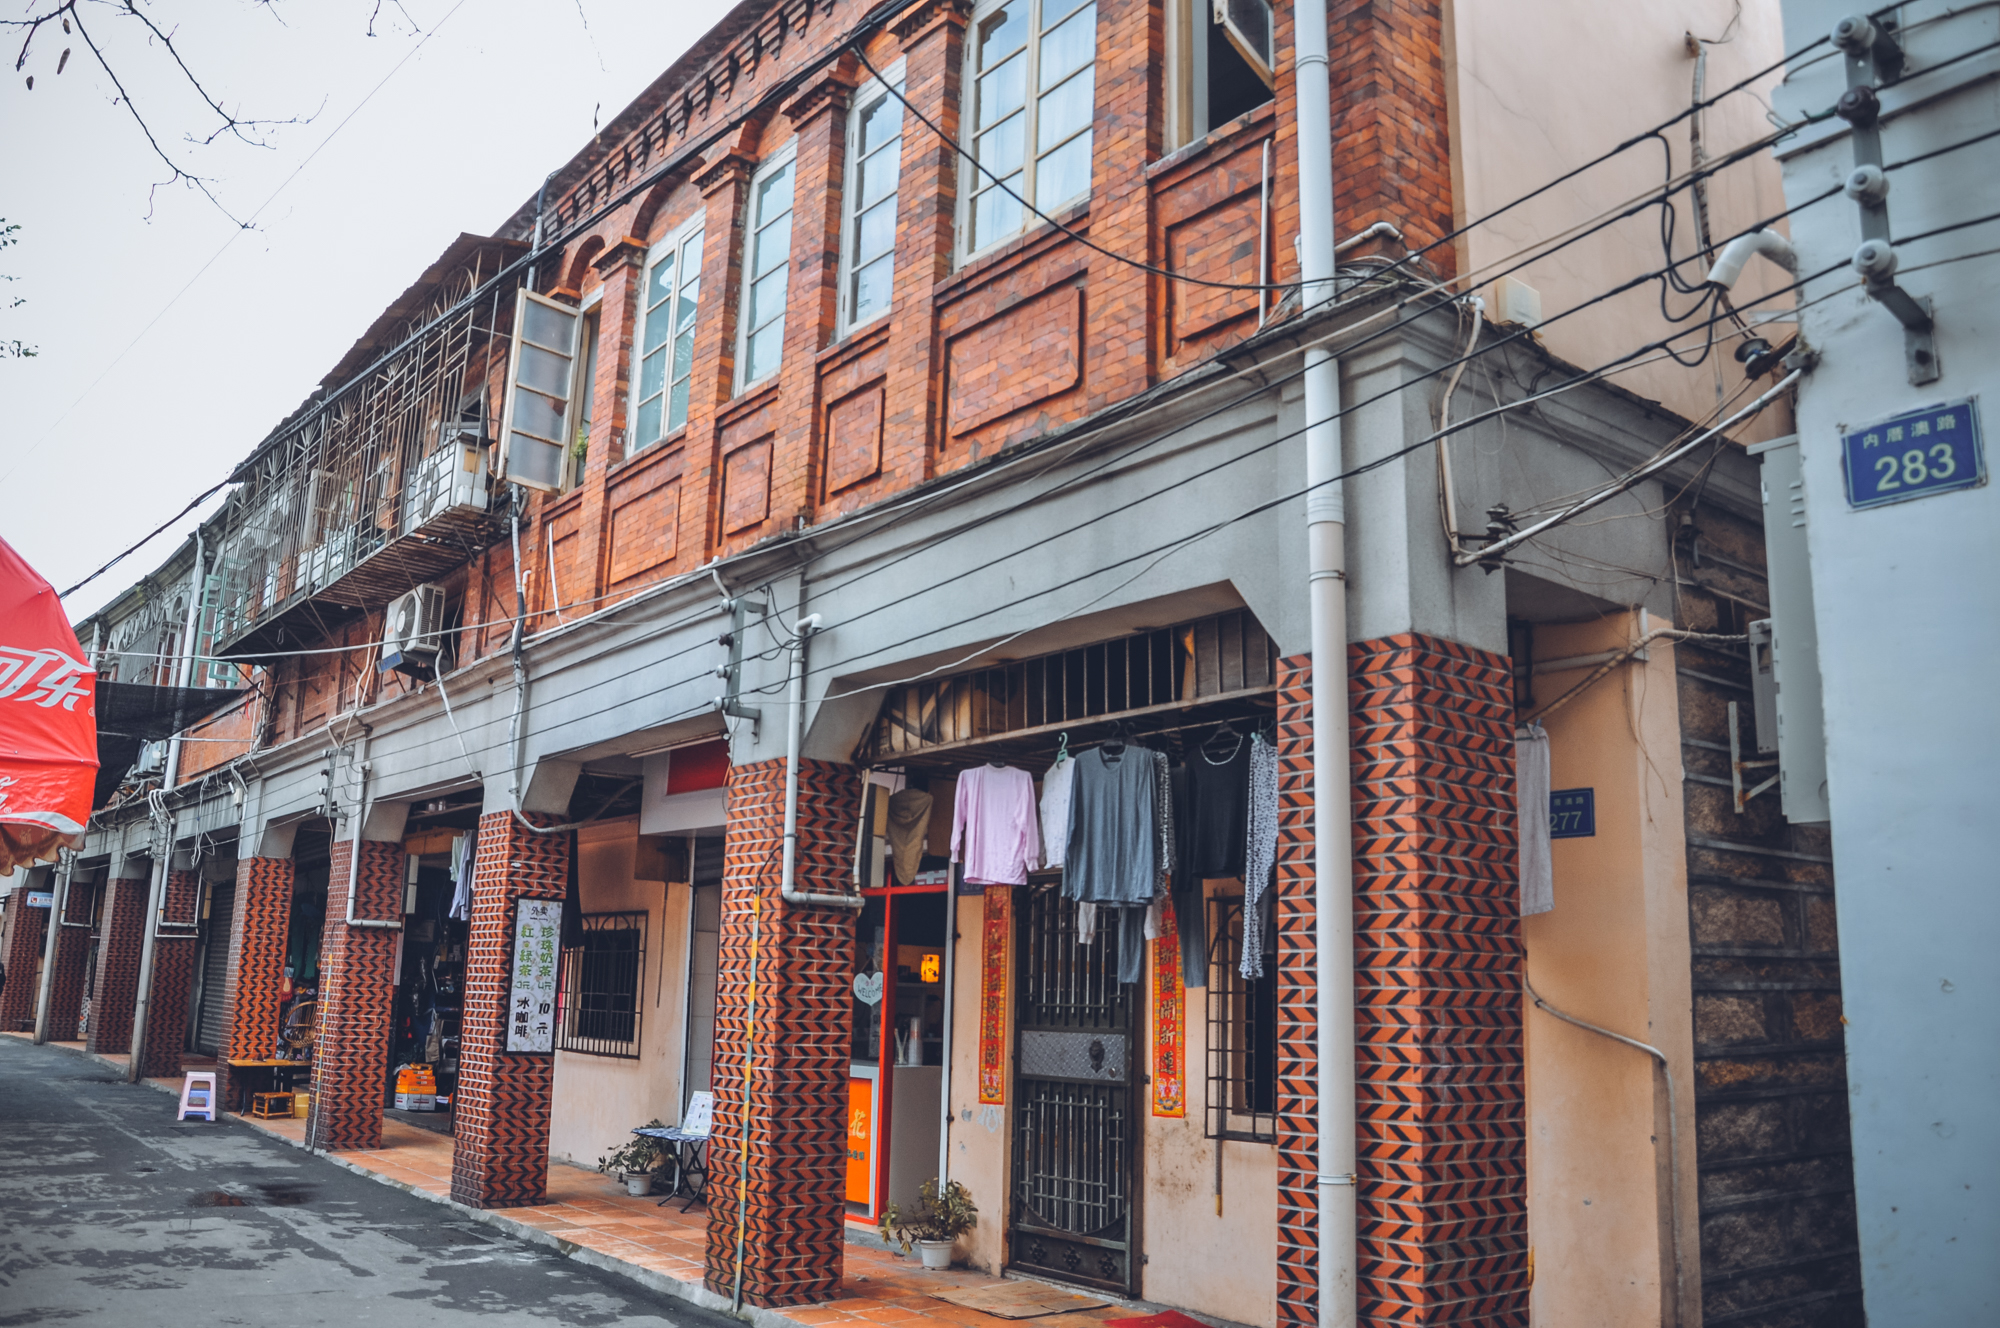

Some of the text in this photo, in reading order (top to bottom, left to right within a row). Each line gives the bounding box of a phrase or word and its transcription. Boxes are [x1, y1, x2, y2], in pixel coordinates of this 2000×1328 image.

[1874, 443, 1956, 491] 283
[1550, 811, 1582, 831] 277
[531, 906, 548, 916] 外卖
[539, 926, 553, 976] 珍珠奶茶
[515, 997, 529, 1038] 冰咖啡
